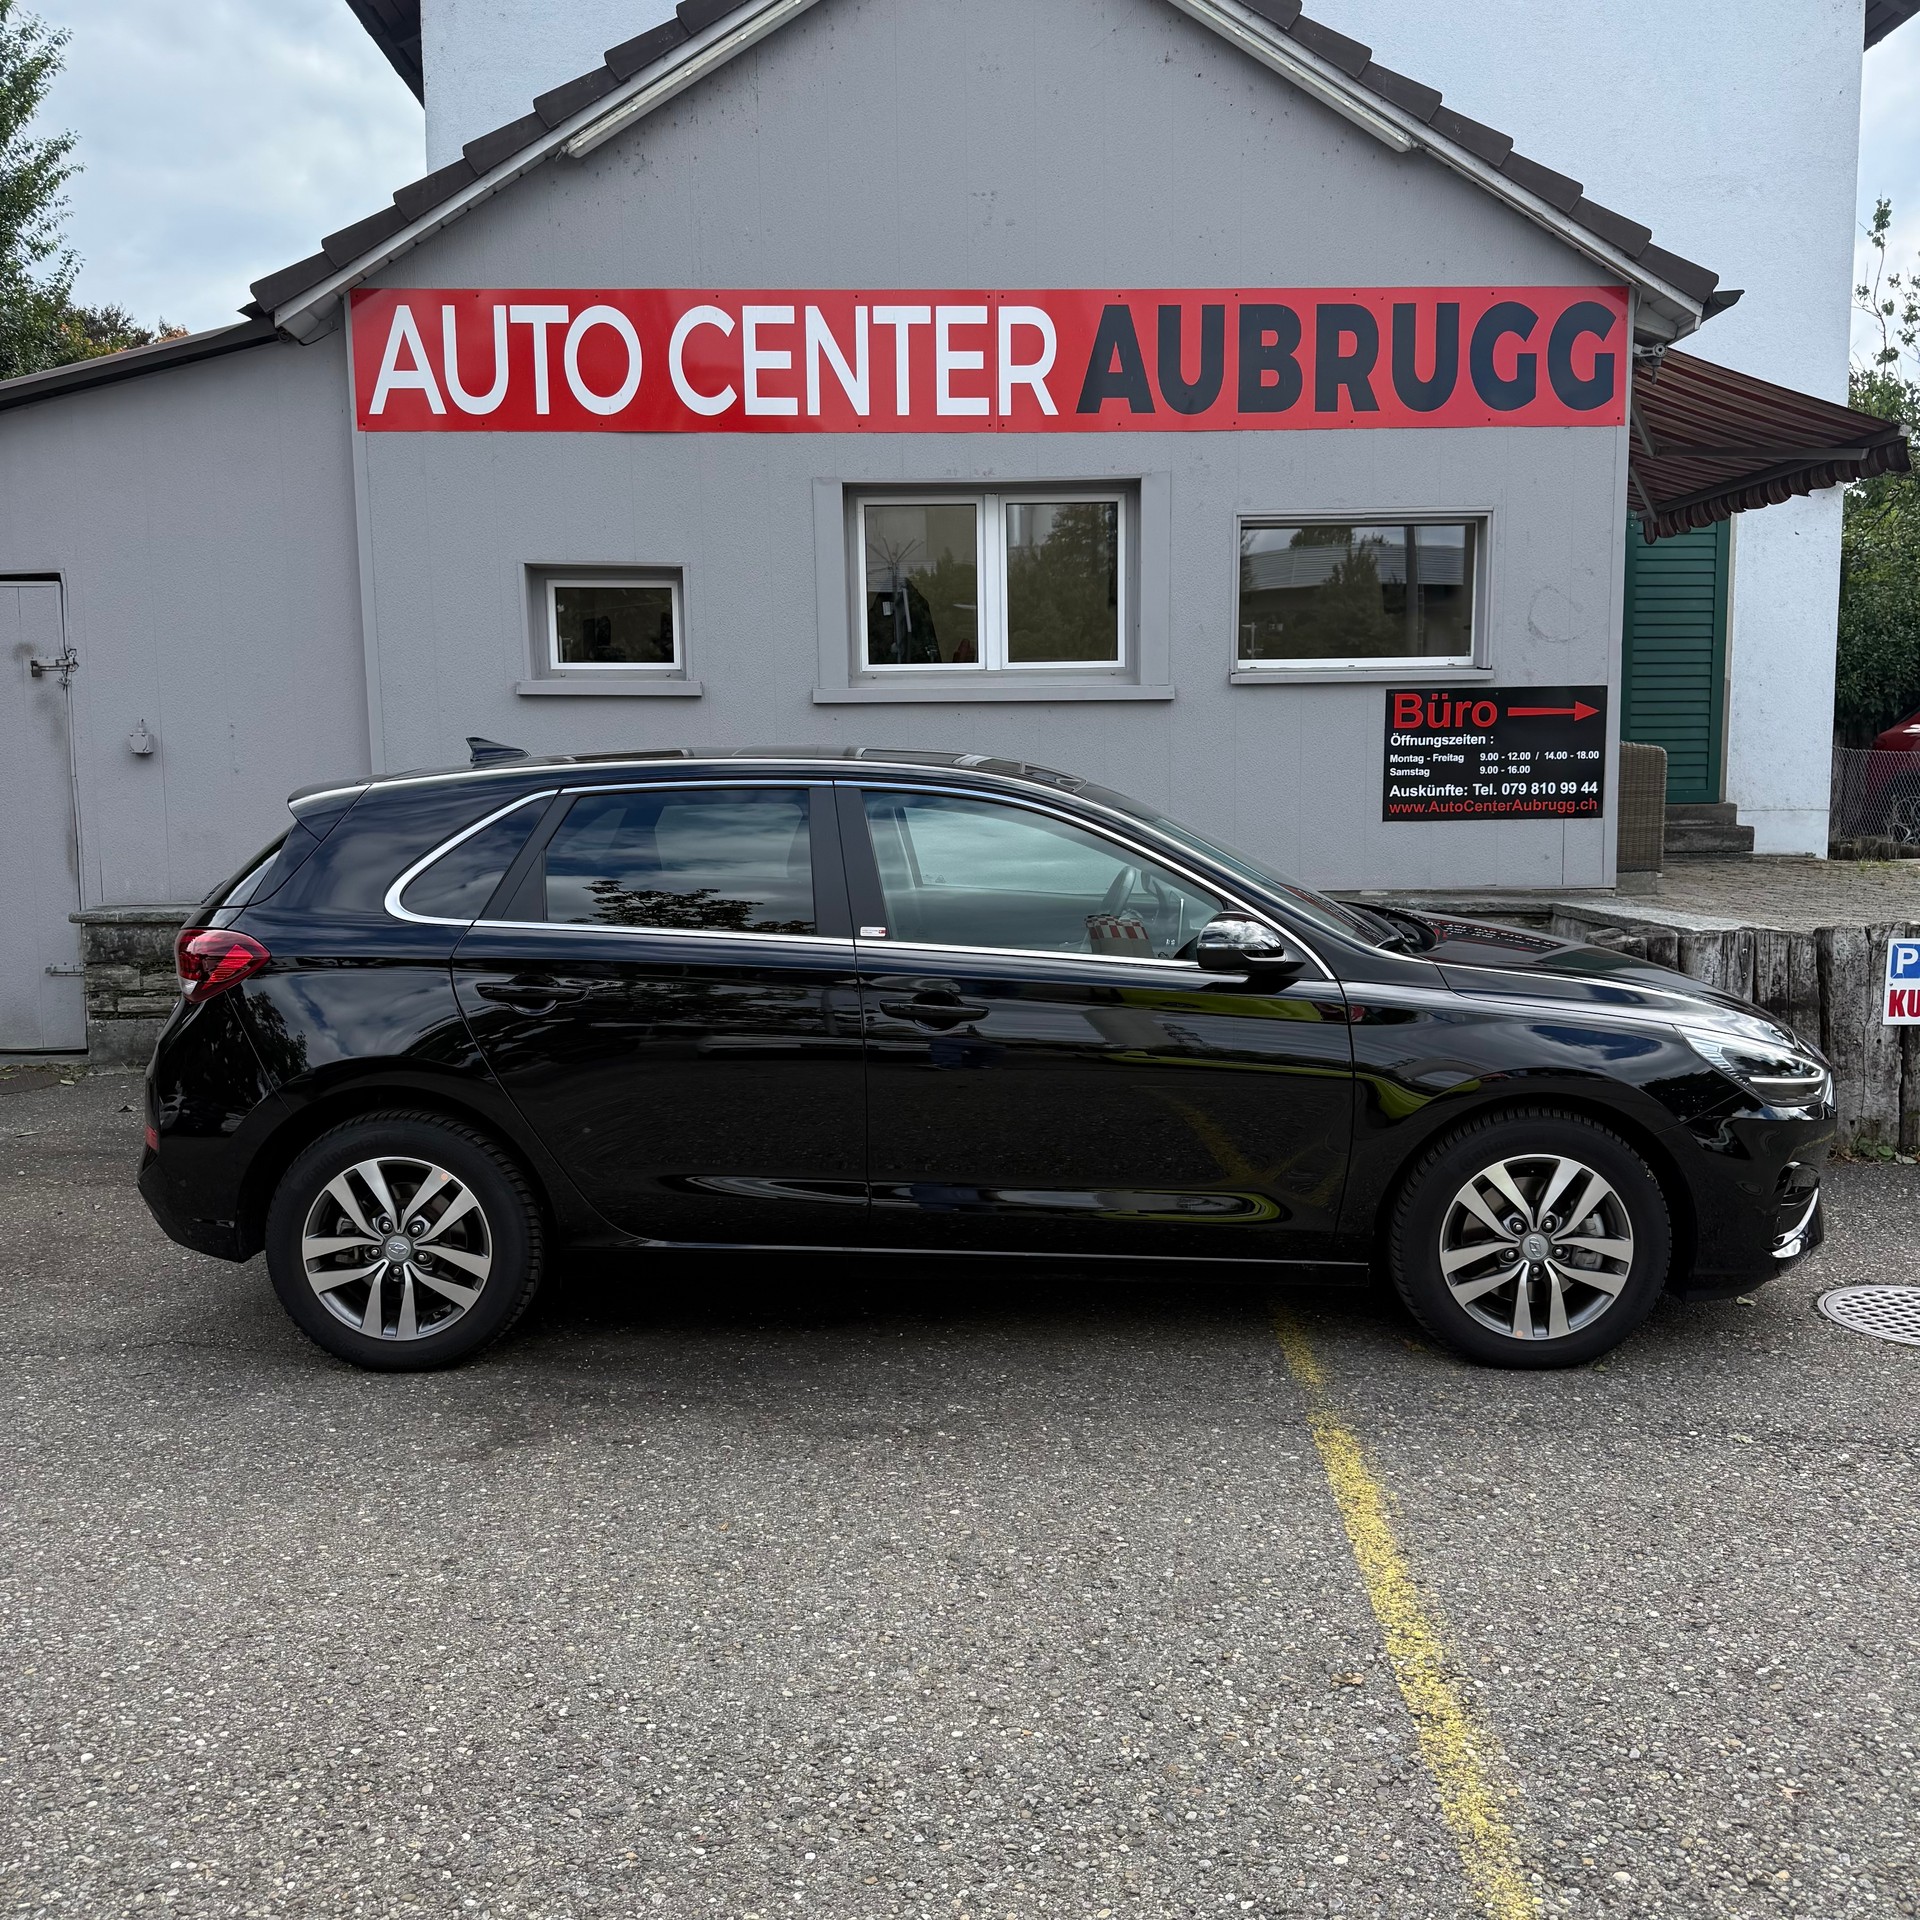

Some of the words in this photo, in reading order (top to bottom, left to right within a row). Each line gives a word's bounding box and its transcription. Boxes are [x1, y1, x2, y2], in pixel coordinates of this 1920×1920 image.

[369, 304, 643, 415] AUTO
[668, 304, 1059, 416] CENTER
[1075, 301, 1617, 415] AUBRUGG
[1393, 693, 1498, 729] Büro
[1390, 732, 1486, 748] Öffnungszeiten
[1389, 754, 1425, 765] Montag
[1432, 753, 1465, 764] Freitag
[1479, 752, 1499, 761] 9.00
[1507, 751, 1531, 761] 12.00
[1544, 751, 1568, 760] 14.00
[1576, 750, 1600, 760] 18.00
[1389, 767, 1431, 778] Samstag
[1479, 765, 1499, 775] 9.00
[1507, 765, 1531, 774] 16.00
[1389, 783, 1469, 798] Auskünfte:
[1472, 782, 1498, 796] Tel.
[1501, 782, 1527, 796] 079
[1530, 781, 1556, 795] 810
[1560, 781, 1577, 795] 99
[1580, 781, 1599, 794] 44
[1388, 798, 1598, 814] www.AutoCenterAubrugg.ch
[1896, 947, 1919, 974] P
